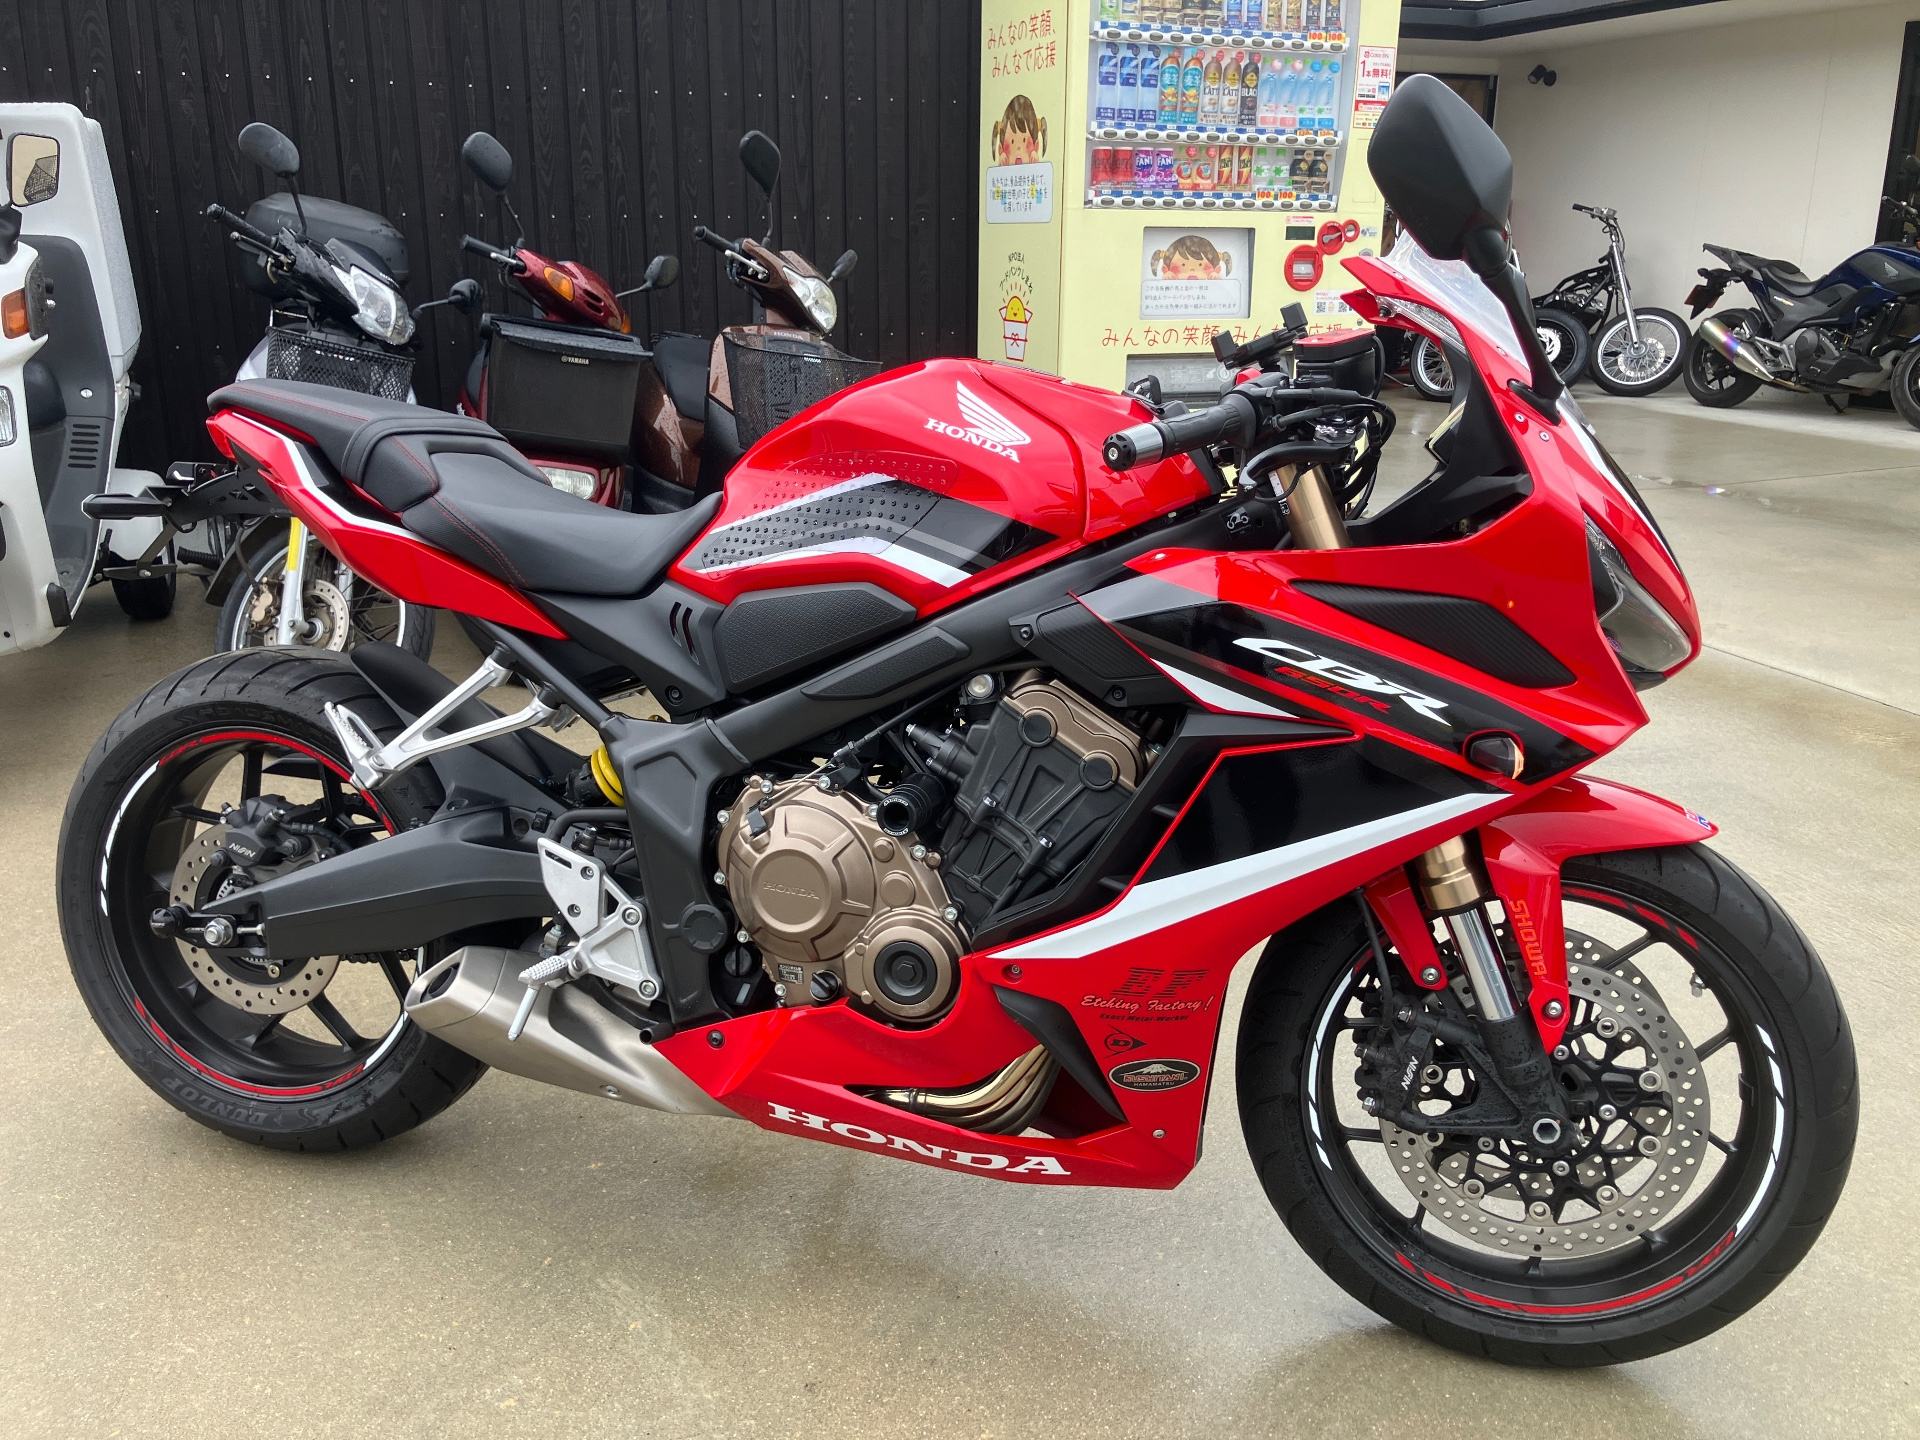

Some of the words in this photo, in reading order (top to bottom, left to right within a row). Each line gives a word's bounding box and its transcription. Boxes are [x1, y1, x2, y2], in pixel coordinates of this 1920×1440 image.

[992, 41, 1056, 77] みんなで応援
[773, 331, 804, 341] HONDA
[568, 356, 590, 365] YAMAHA
[924, 417, 1020, 463] HONDA
[1232, 637, 1452, 727] CBR
[1274, 666, 1392, 714] 650R
[763, 881, 820, 900] HONDA
[1509, 899, 1548, 980] SHOWA
[1081, 994, 1141, 1014] Etching
[1099, 1013, 1125, 1021] Exact
[1123, 1072, 1184, 1082] KUSHITANI
[162, 1077, 269, 1126] DUNLOP
[767, 1101, 1072, 1176] HONDA
